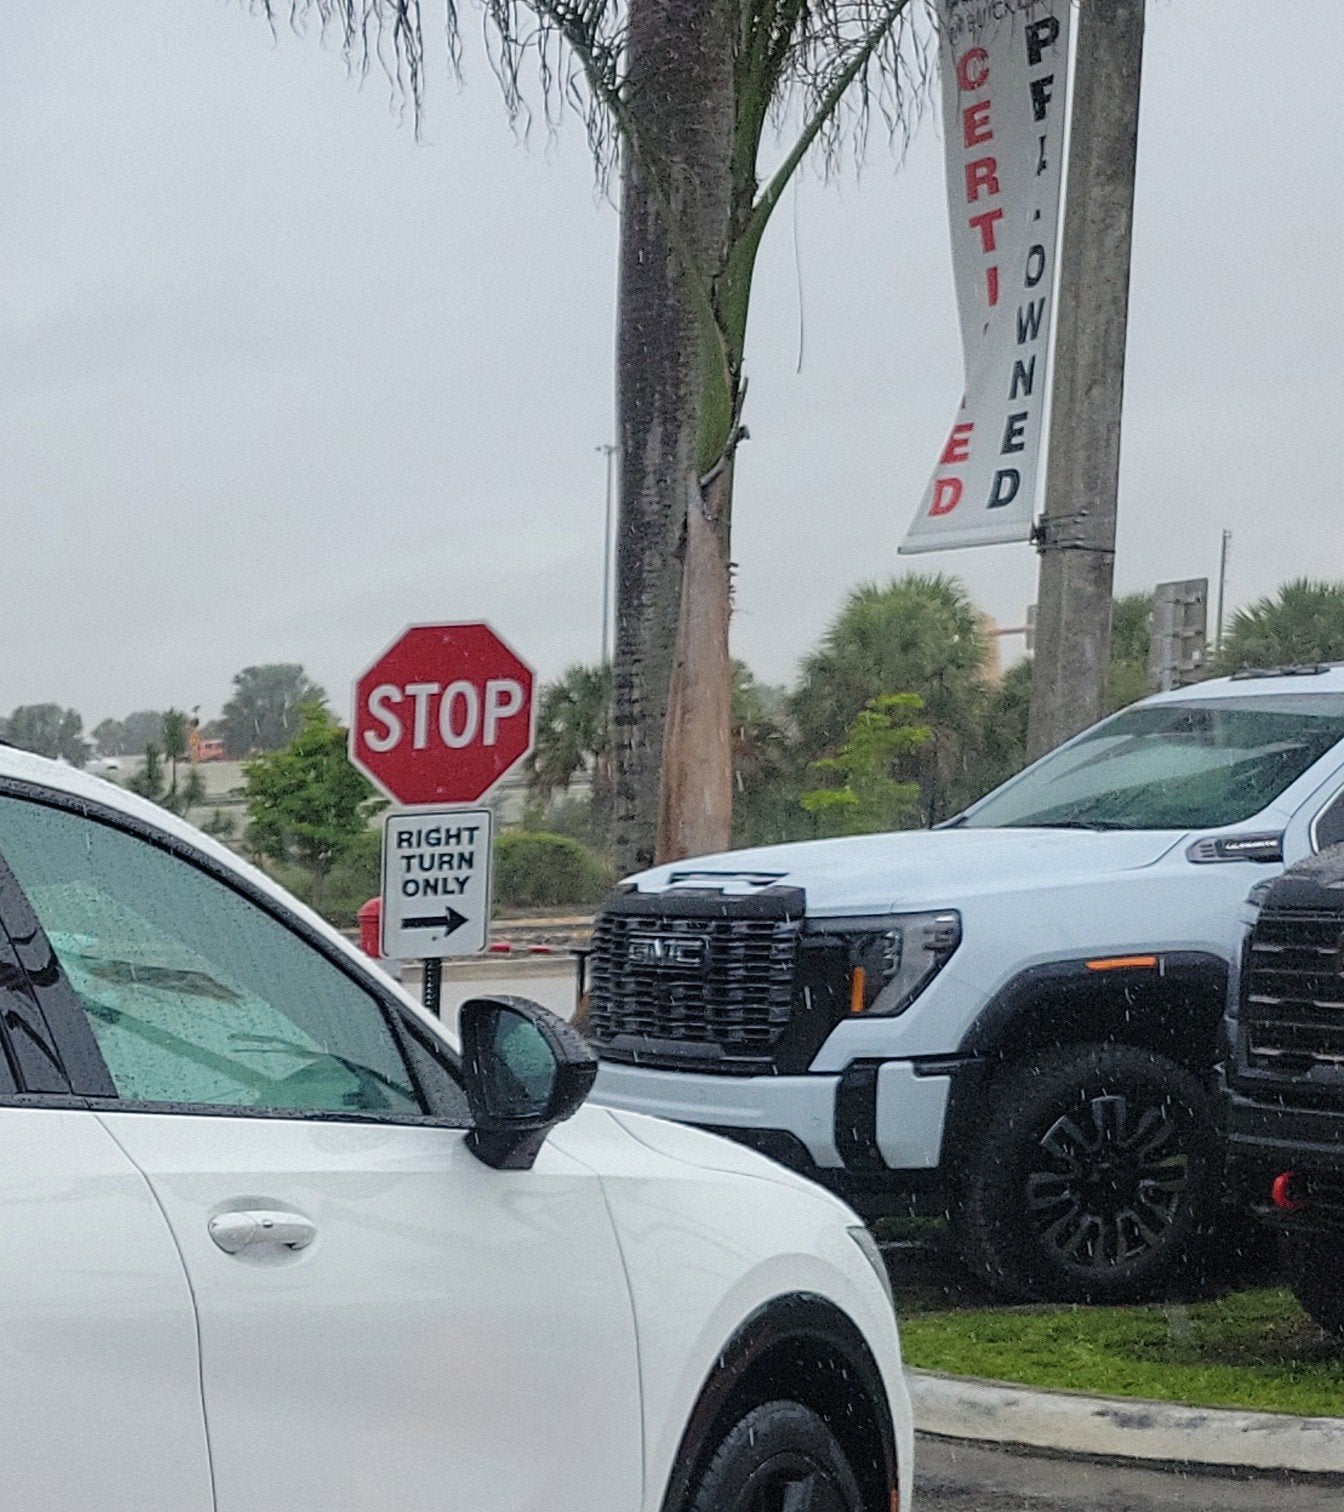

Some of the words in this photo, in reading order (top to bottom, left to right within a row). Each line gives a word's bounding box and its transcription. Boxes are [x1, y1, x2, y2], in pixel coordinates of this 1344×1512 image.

[928, 47, 1003, 517] CERTIED
[363, 680, 523, 752] STOP
[396, 826, 479, 850] RIGHT
[401, 851, 474, 873] TURN
[402, 876, 471, 897] ONLY
